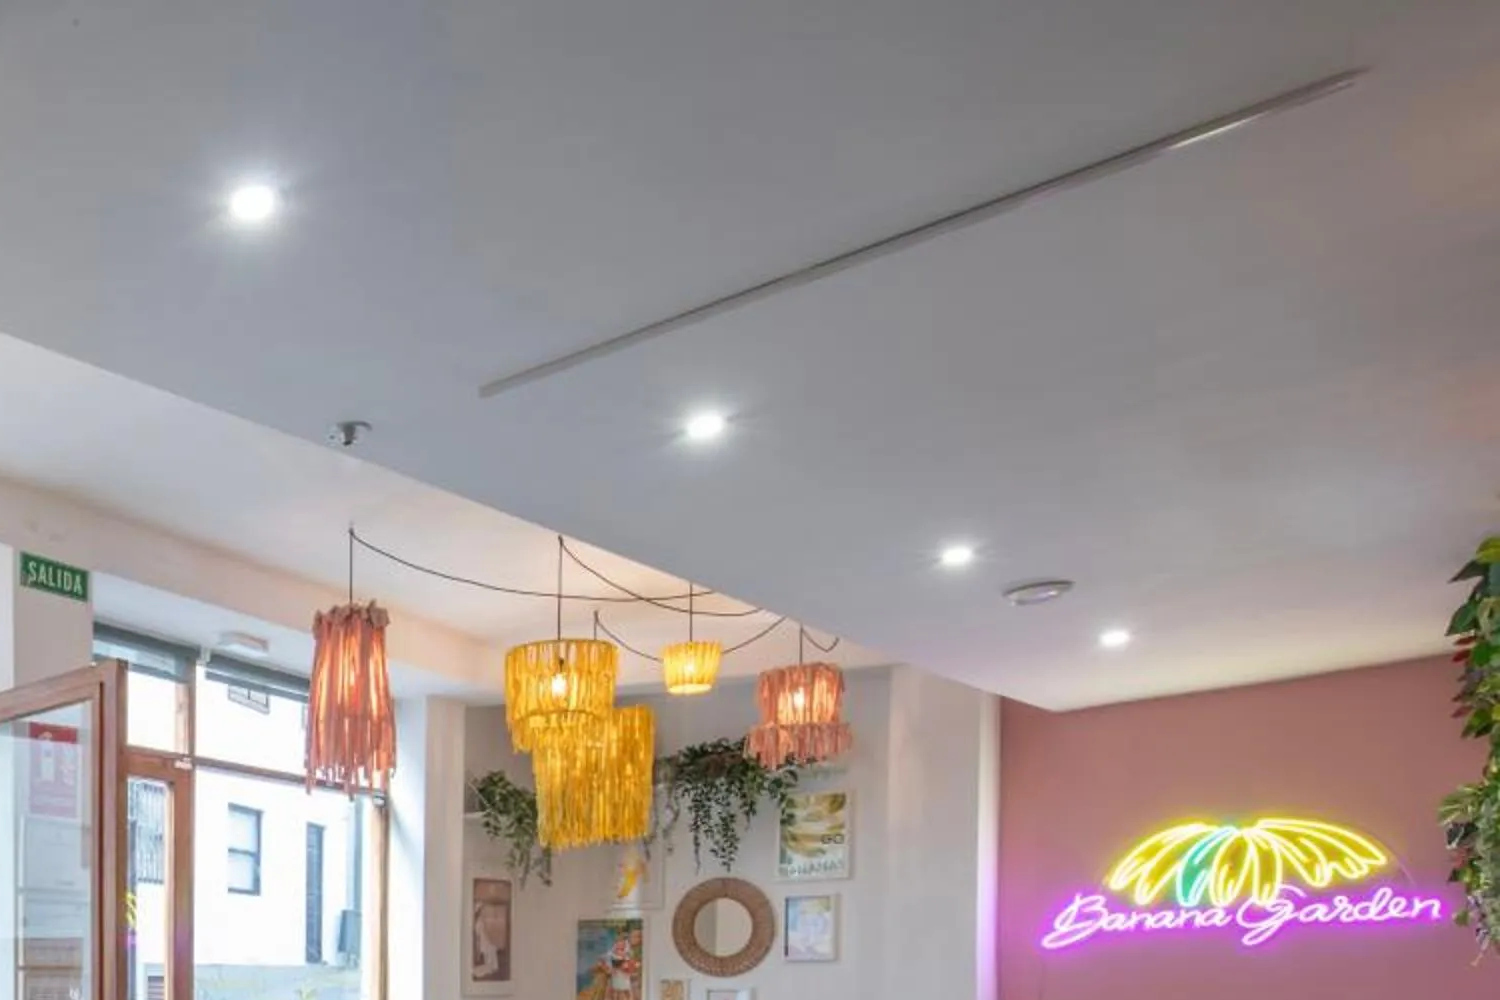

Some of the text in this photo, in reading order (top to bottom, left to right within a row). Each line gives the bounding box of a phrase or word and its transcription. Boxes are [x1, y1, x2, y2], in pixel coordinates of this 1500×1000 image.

[27, 560, 84, 595] SALIDA
[1041, 883, 1441, 949] Banana Garden
